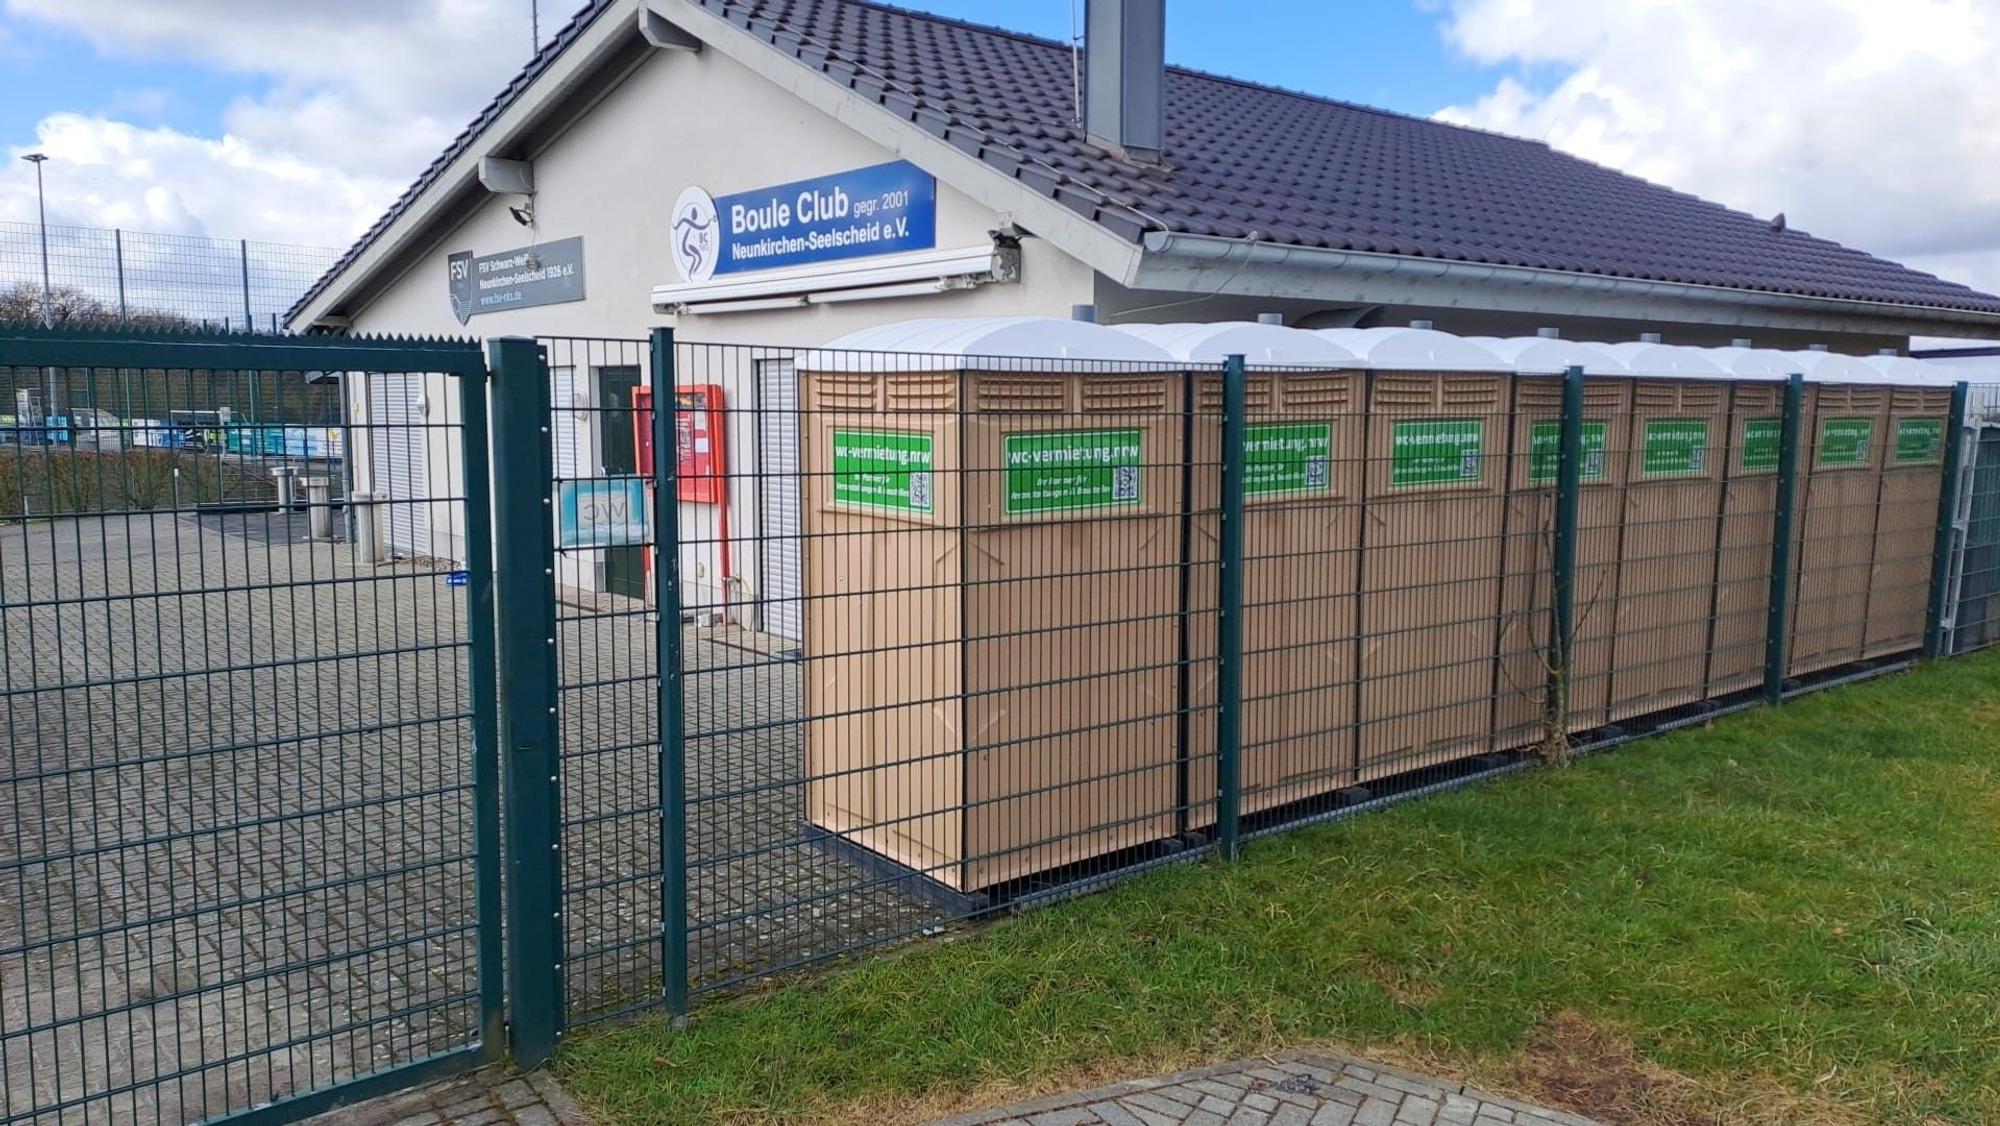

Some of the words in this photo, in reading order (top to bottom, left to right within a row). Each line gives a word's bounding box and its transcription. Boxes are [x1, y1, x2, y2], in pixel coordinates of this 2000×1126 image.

[731, 198, 790, 234] Boule
[797, 186, 848, 224] Club
[853, 200, 879, 218] gegr.
[882, 190, 909, 210] 2001
[732, 223, 880, 260] Neunkirchen-Seelscheid
[883, 217, 909, 239] e.V.
[450, 258, 469, 280] FSV
[478, 261, 489, 273] FSV
